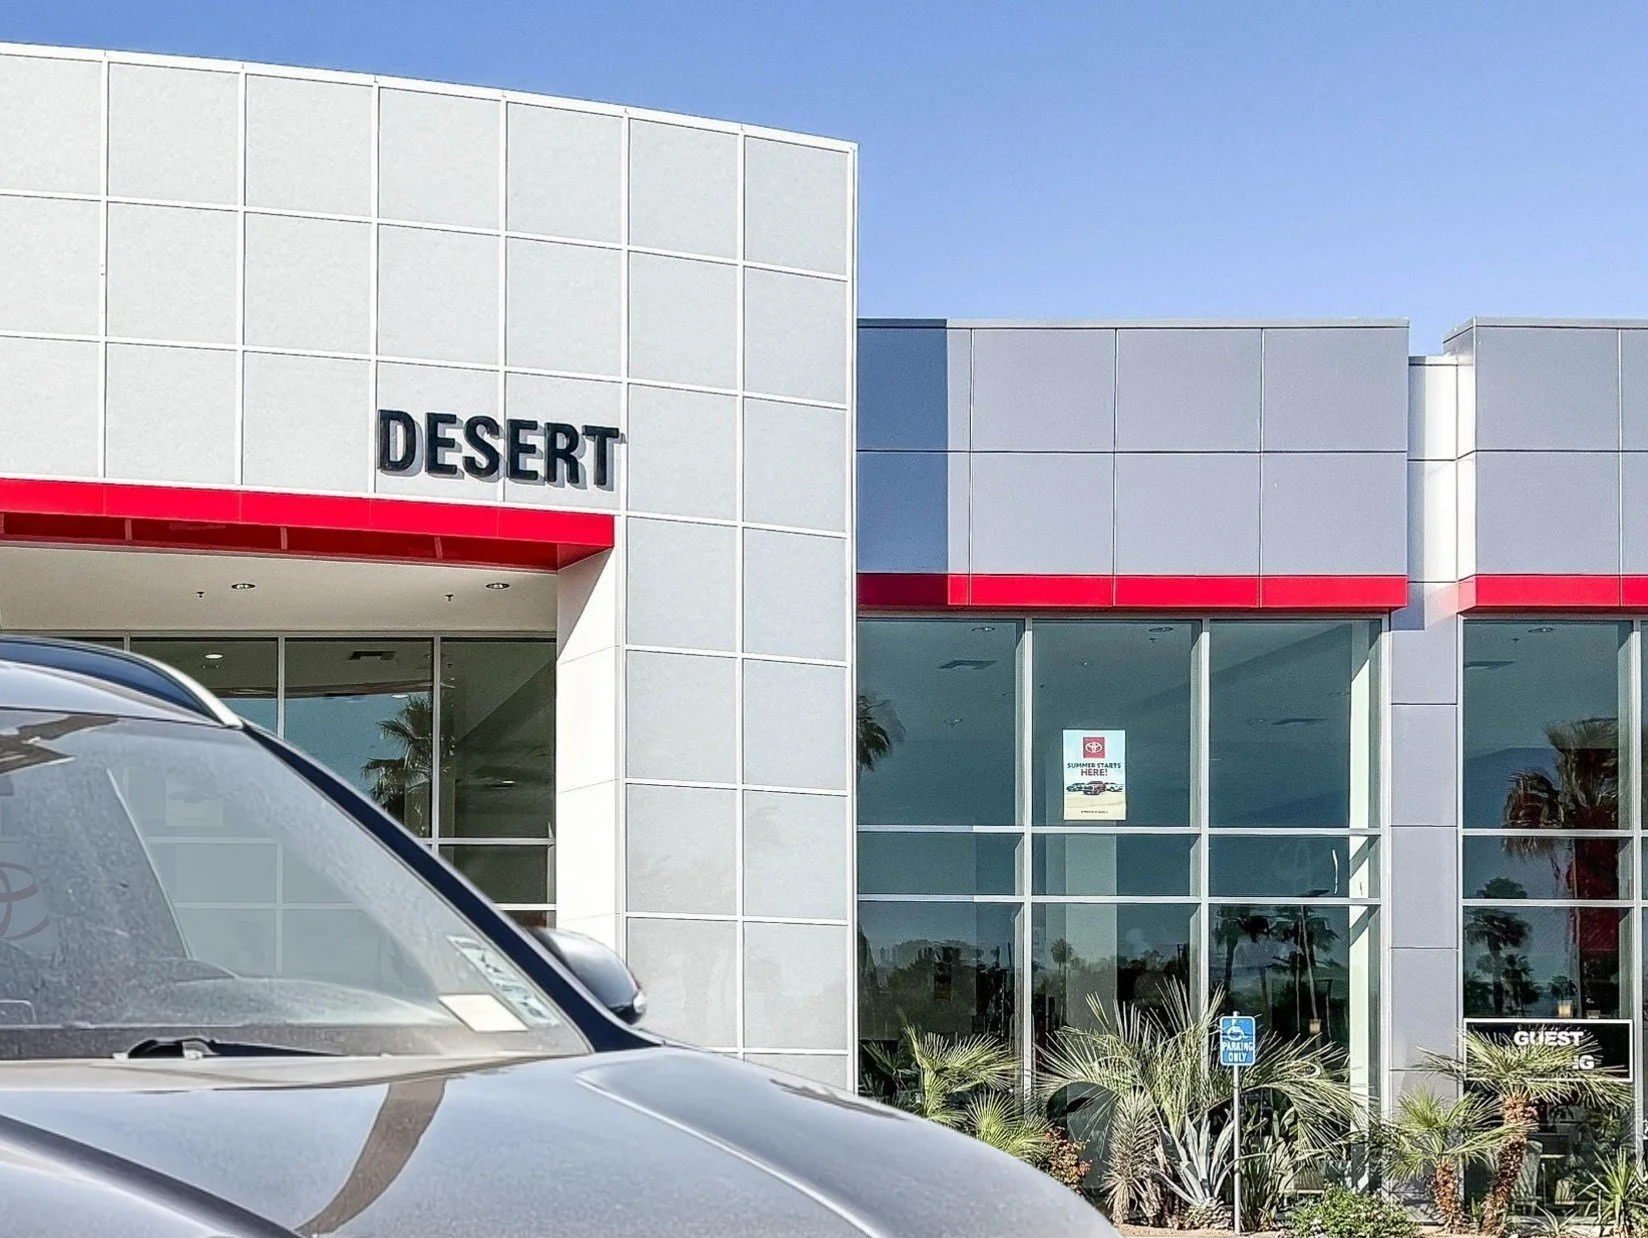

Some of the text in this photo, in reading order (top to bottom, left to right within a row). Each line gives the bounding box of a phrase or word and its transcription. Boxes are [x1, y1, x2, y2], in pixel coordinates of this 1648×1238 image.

[377, 409, 620, 486] DESERT
[1080, 768, 1108, 777] HERE!
[1513, 1031, 1584, 1046] GUEST
[1222, 1041, 1255, 1051] PARKING
[1228, 1051, 1248, 1063] ONLY
